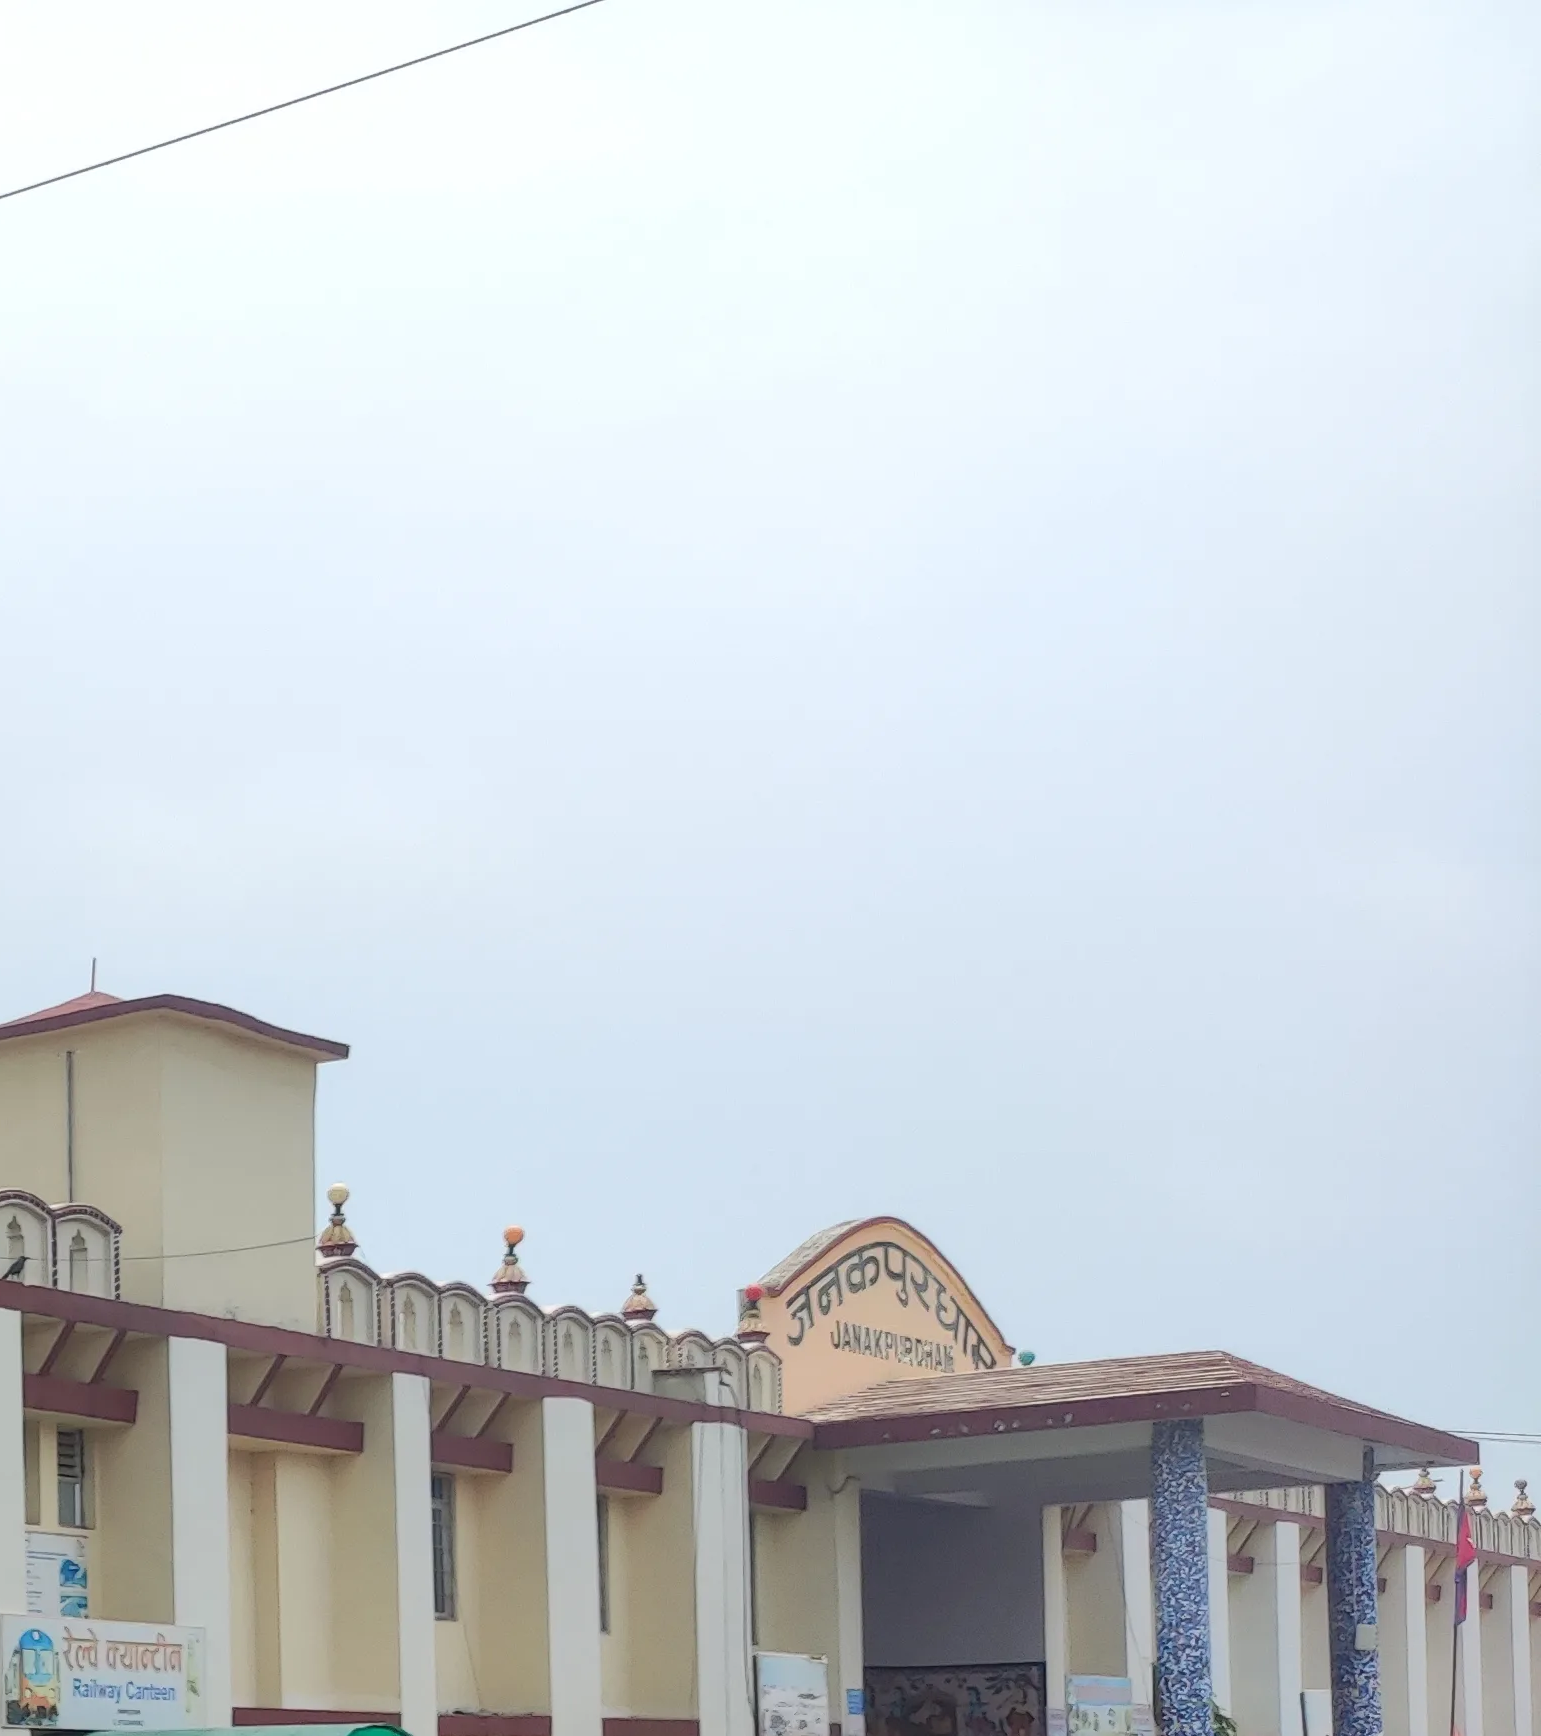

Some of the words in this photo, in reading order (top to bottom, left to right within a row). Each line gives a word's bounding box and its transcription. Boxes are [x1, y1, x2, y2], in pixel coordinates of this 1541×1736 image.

[786, 1241, 997, 1370] जनकपुरधाम
[72, 1678, 123, 1704] Railway
[126, 1681, 176, 1702] Canteen
